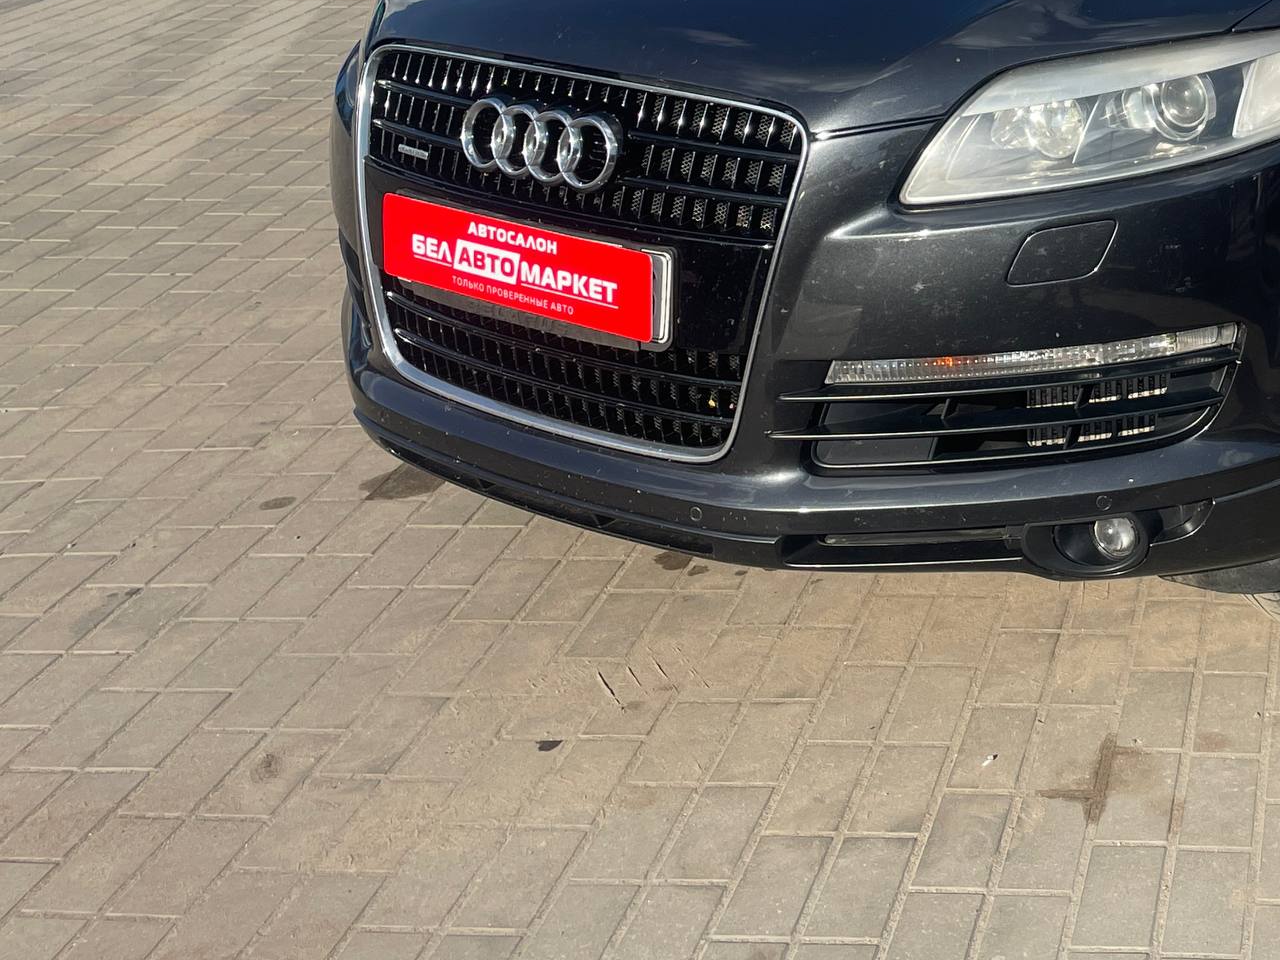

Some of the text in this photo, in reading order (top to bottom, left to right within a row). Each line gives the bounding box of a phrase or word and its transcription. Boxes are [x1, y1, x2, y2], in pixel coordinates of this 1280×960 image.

[467, 222, 558, 255] АВТОСАЛОН
[411, 234, 618, 303] БЕЛ АВТО МАРКЕТ
[451, 275, 574, 316] ТОЛЬКО ПРОВЕРЕННЫЕ АВТО
